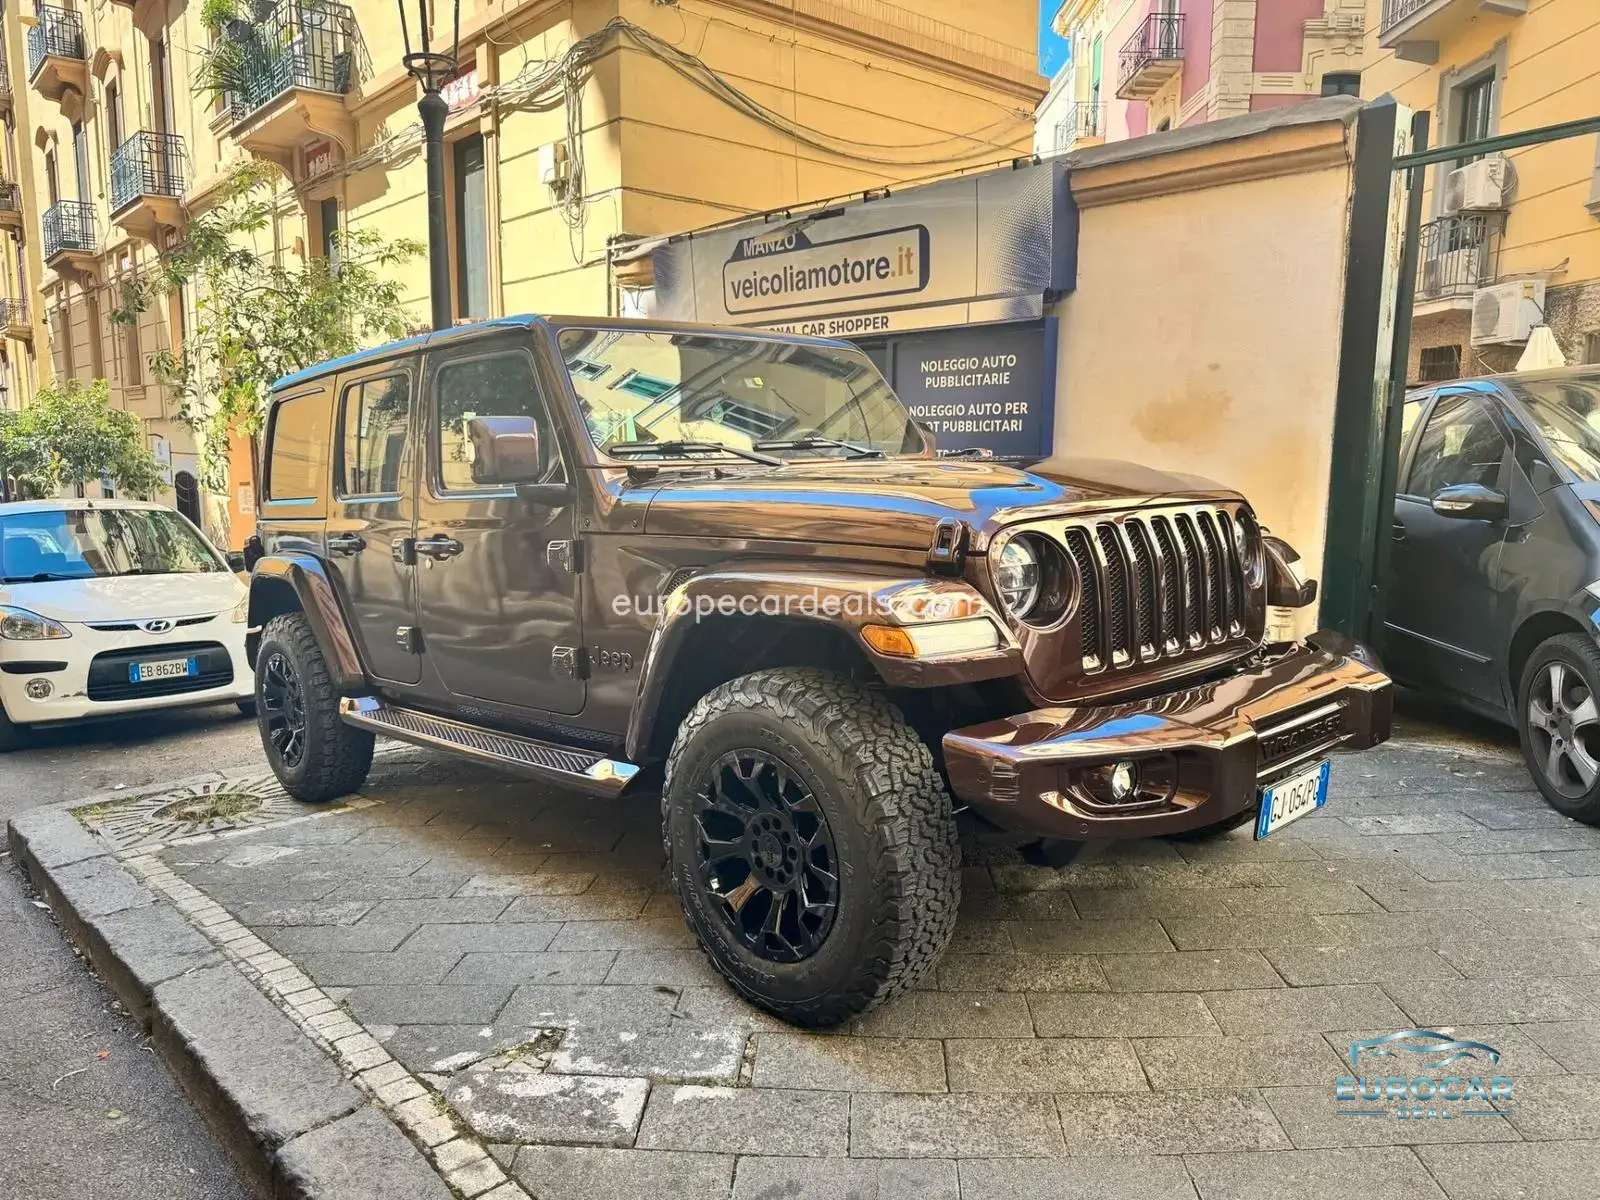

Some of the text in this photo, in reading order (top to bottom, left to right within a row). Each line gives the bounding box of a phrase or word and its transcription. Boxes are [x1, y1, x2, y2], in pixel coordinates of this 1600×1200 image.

[731, 246, 914, 300] veicoliamotore.it
[802, 322, 825, 336] CAR
[829, 315, 889, 334] SHOPPER
[920, 354, 1017, 373] NOLEGGIO AUTO
[925, 372, 1011, 389] PUBBLICITARIE
[909, 402, 1028, 417] NOLEGGIO AUTO PER
[942, 419, 1023, 433] PUBBLICITARI
[588, 645, 634, 673] Jeep
